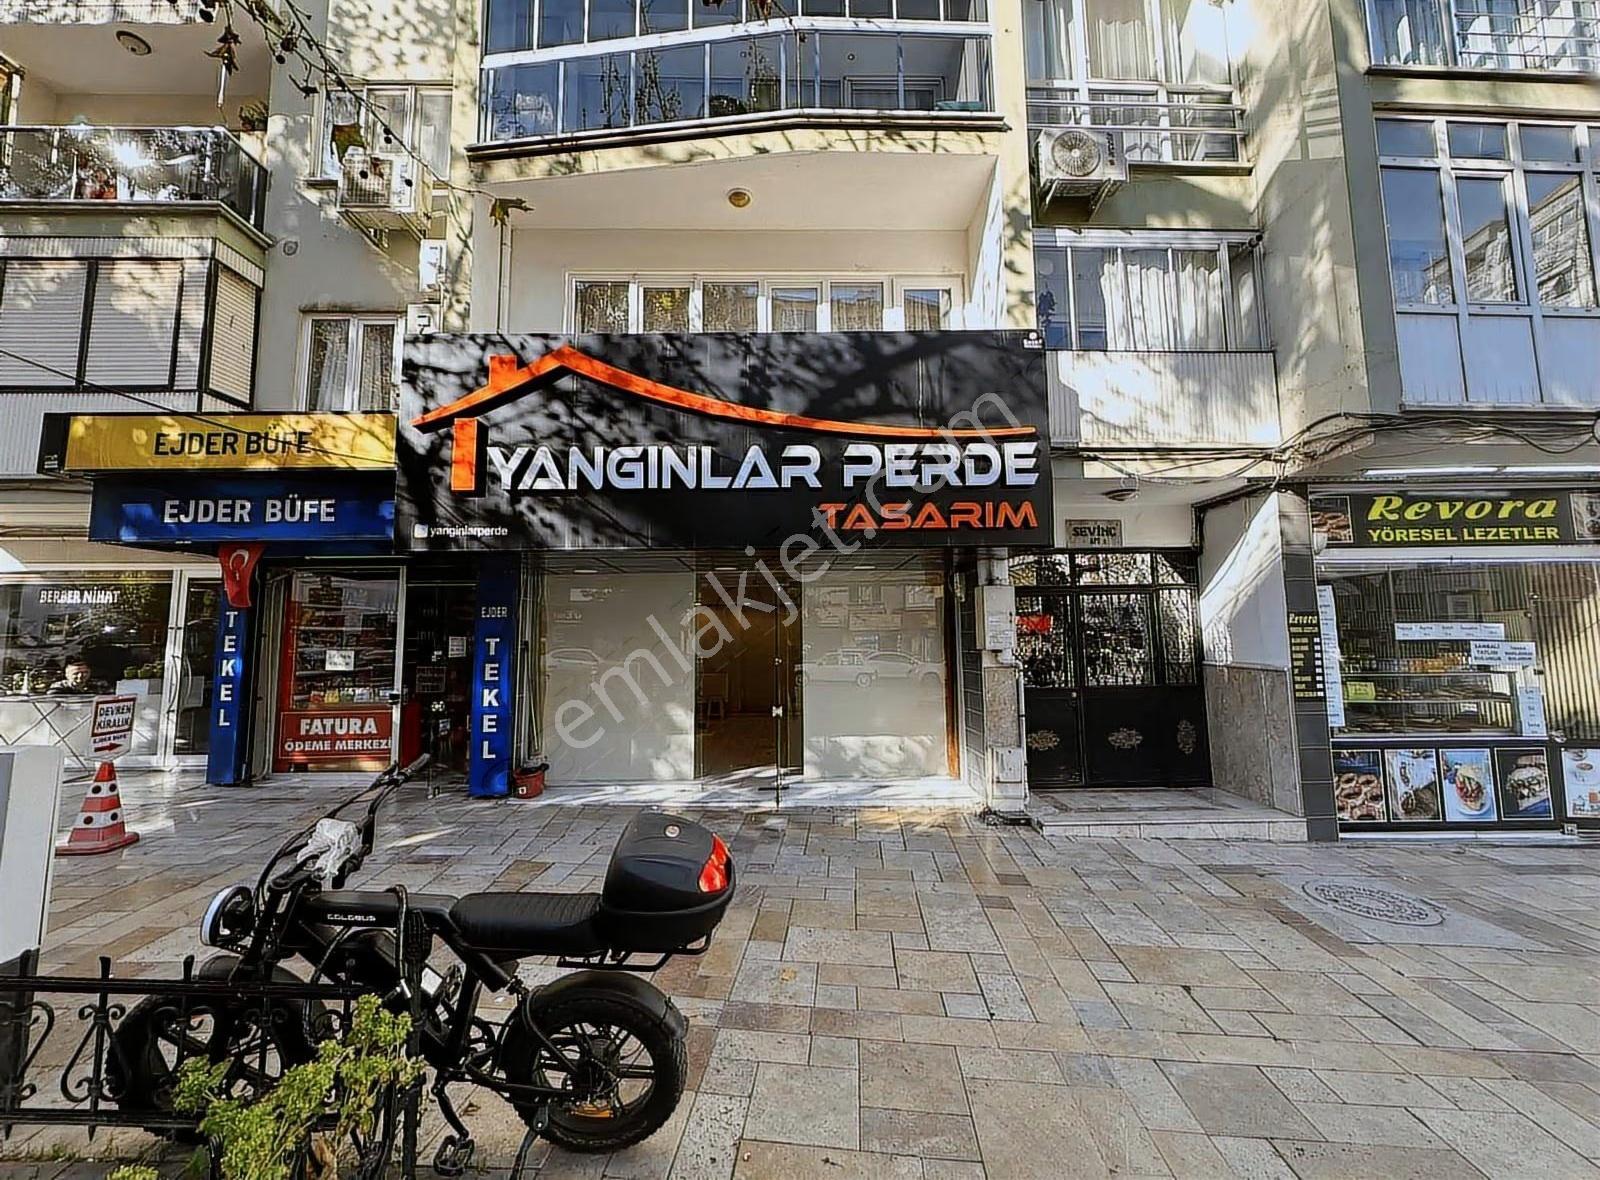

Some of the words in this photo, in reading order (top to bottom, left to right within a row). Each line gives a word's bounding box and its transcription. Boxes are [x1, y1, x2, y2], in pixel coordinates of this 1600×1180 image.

[154, 432, 239, 456] EJDER
[246, 424, 313, 455] BÜFE
[486, 446, 822, 490] YANGINLAR
[843, 442, 1039, 487] PERDE
[163, 499, 251, 523] EJDER
[265, 493, 335, 523] BÜFE
[817, 500, 1038, 530] TASARIM
[1367, 495, 1557, 521] Revora
[1368, 526, 1458, 542] YÖRESEL
[1463, 527, 1559, 541] LEZETLER
[40, 590, 81, 604] BERBER
[82, 586, 120, 604] NİHAT
[481, 606, 508, 618] EJDER
[218, 611, 239, 726] TEKEL
[482, 637, 501, 760] TEKEL
[300, 717, 378, 735] FATURA
[284, 738, 331, 751] ÖDEME
